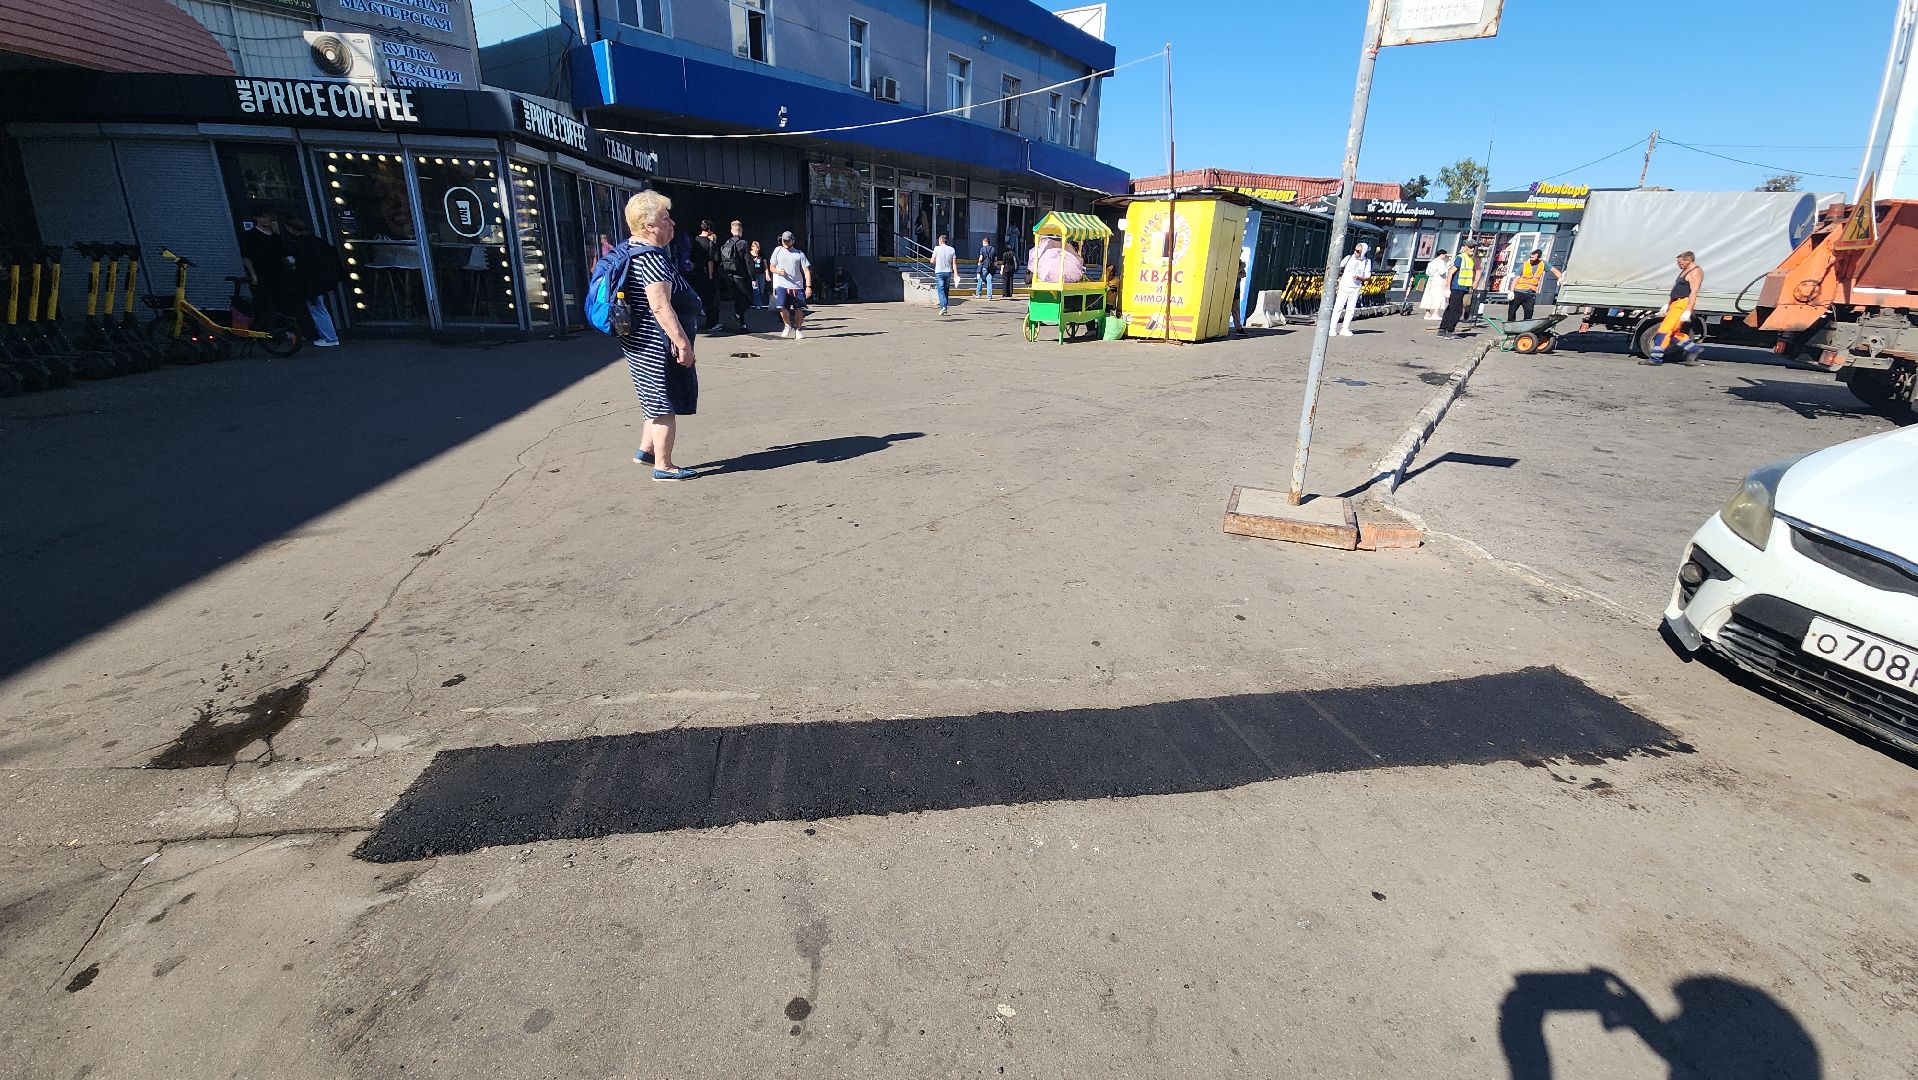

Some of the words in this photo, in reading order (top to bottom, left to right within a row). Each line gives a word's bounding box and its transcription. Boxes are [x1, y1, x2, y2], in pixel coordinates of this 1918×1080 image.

[341, 0, 452, 32] МАСТЕРСКАЯ
[236, 80, 256, 113] ONE
[252, 81, 329, 117] PRICE
[328, 84, 418, 122] COFFEE
[529, 104, 558, 141] PRICE
[557, 114, 588, 152] COFFEE
[1140, 269, 1184, 284] КВАС
